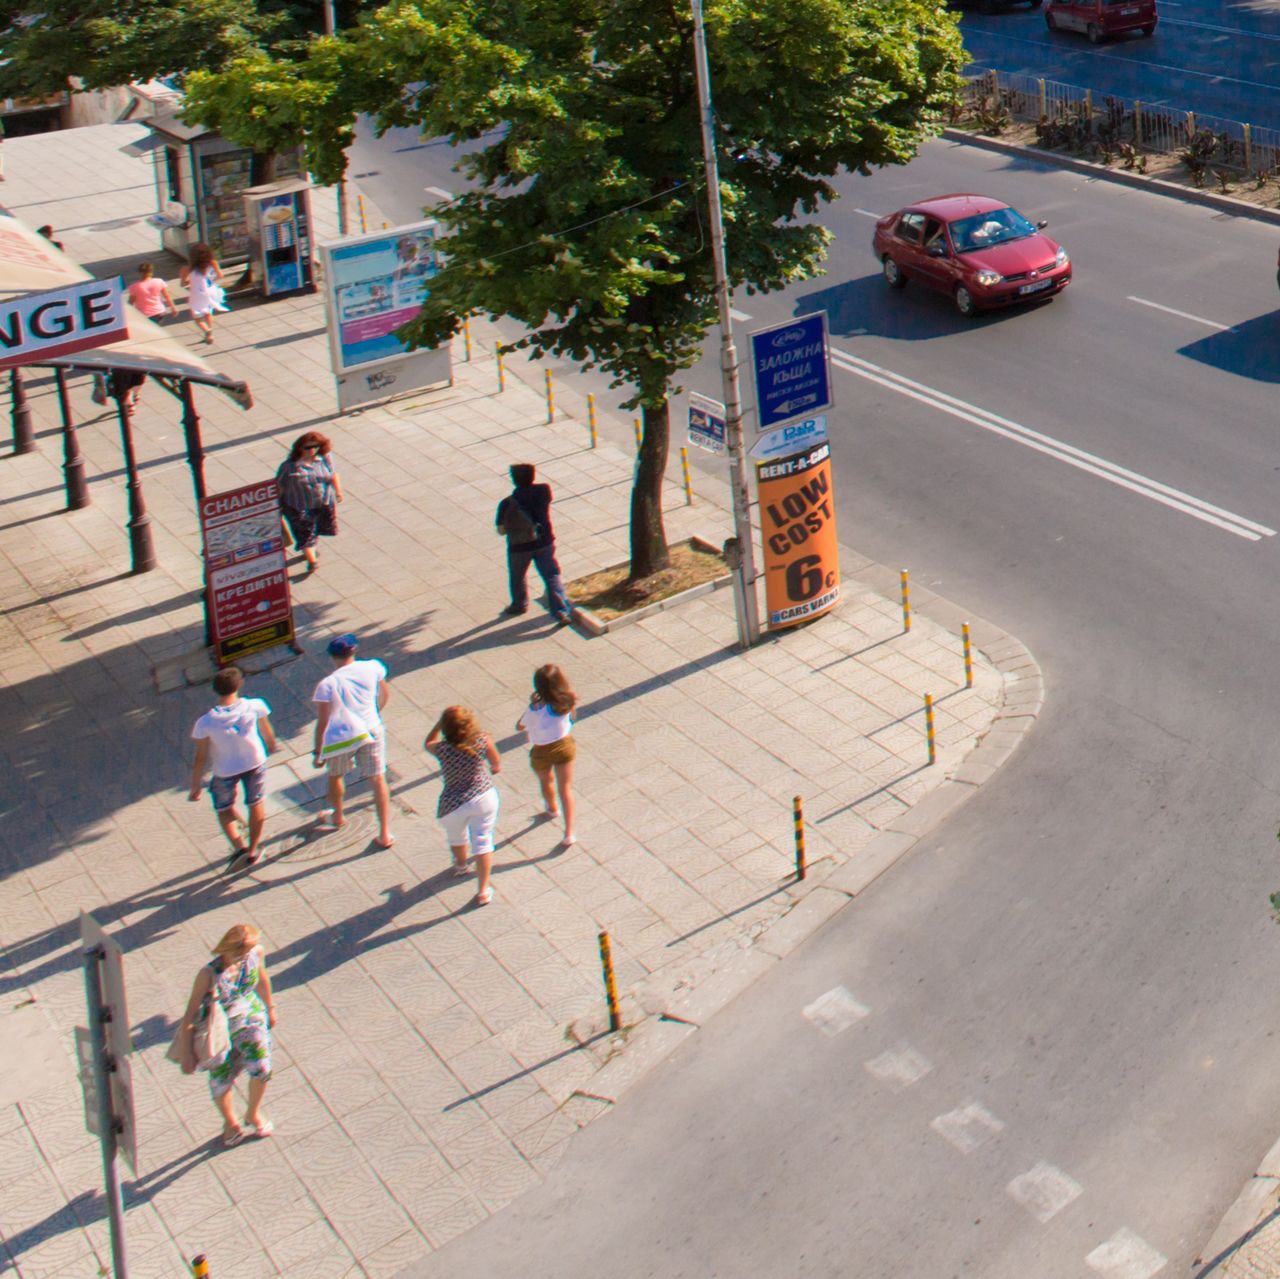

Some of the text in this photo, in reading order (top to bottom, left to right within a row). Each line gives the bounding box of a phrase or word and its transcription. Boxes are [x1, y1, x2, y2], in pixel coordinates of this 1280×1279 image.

[759, 341, 822, 373] ЗАЛОЖНА
[773, 362, 812, 386] КЪЩА
[203, 483, 278, 516] CHANGE
[766, 469, 829, 528] LOW
[768, 499, 831, 555] COST
[780, 603, 810, 621] CARS
